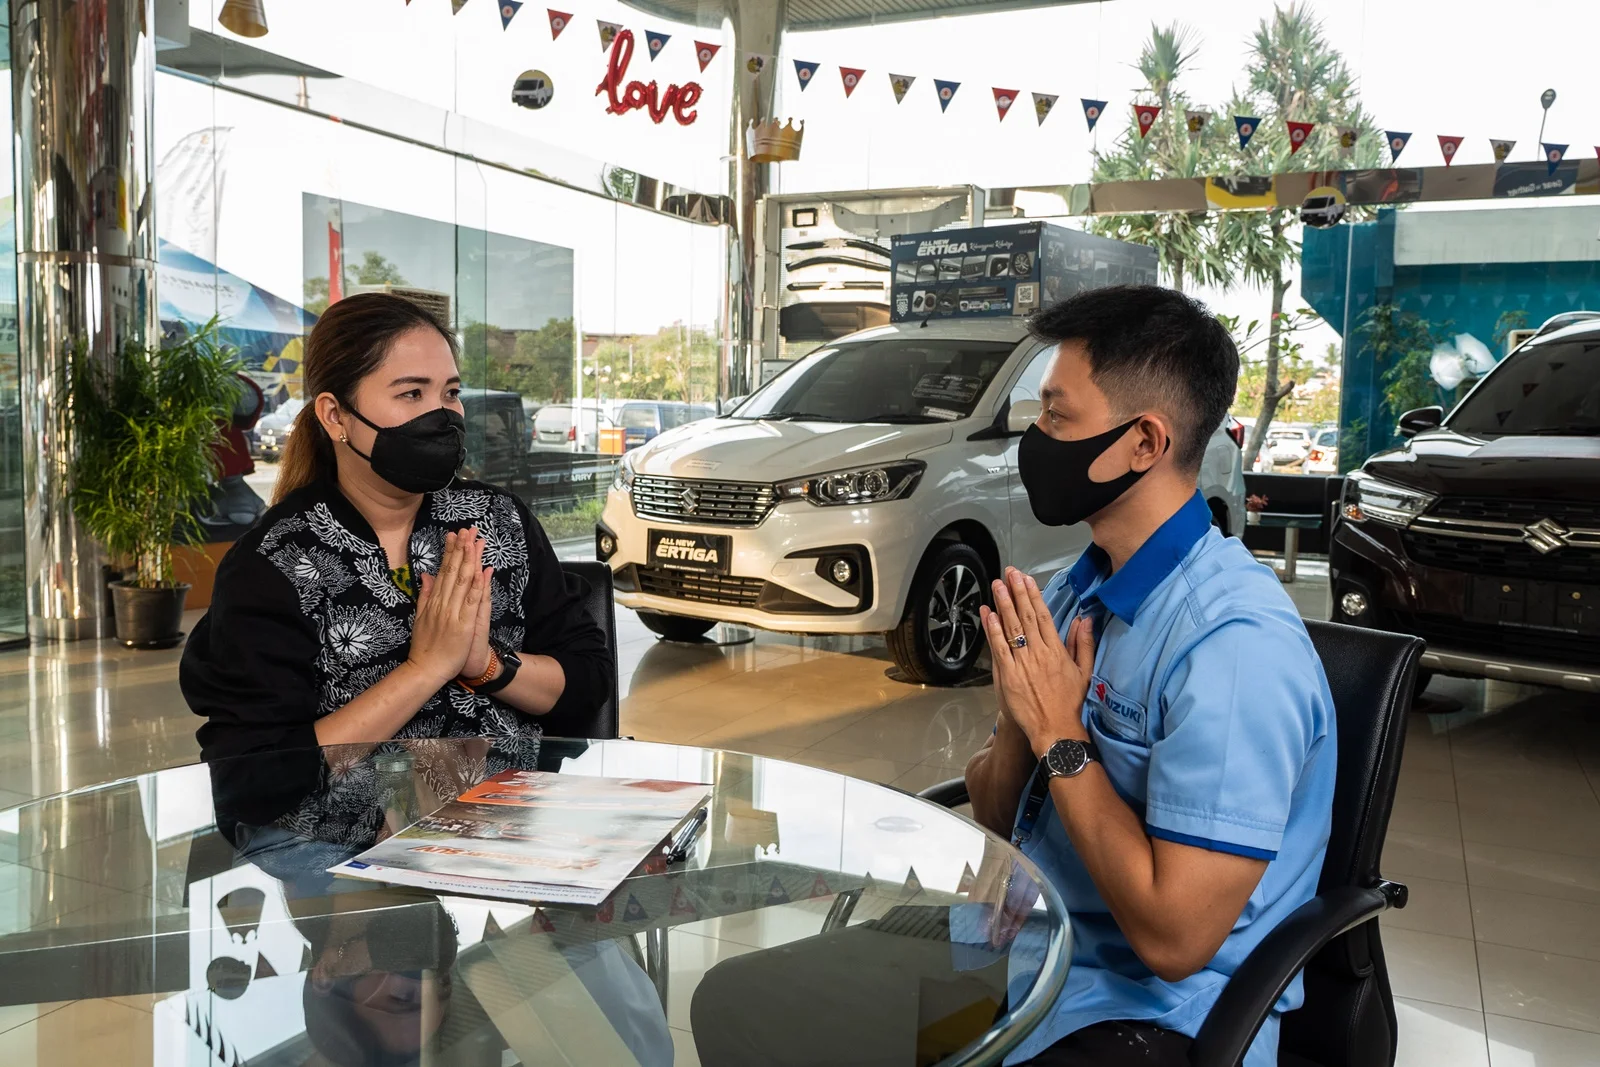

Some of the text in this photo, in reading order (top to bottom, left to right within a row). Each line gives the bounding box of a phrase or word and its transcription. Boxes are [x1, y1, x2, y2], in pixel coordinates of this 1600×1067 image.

[595, 29, 703, 125] love
[917, 242, 968, 256] ERTIGA
[933, 238, 950, 246] NEW
[659, 537, 696, 547] ALL NEW
[655, 544, 718, 563] ERTIGA
